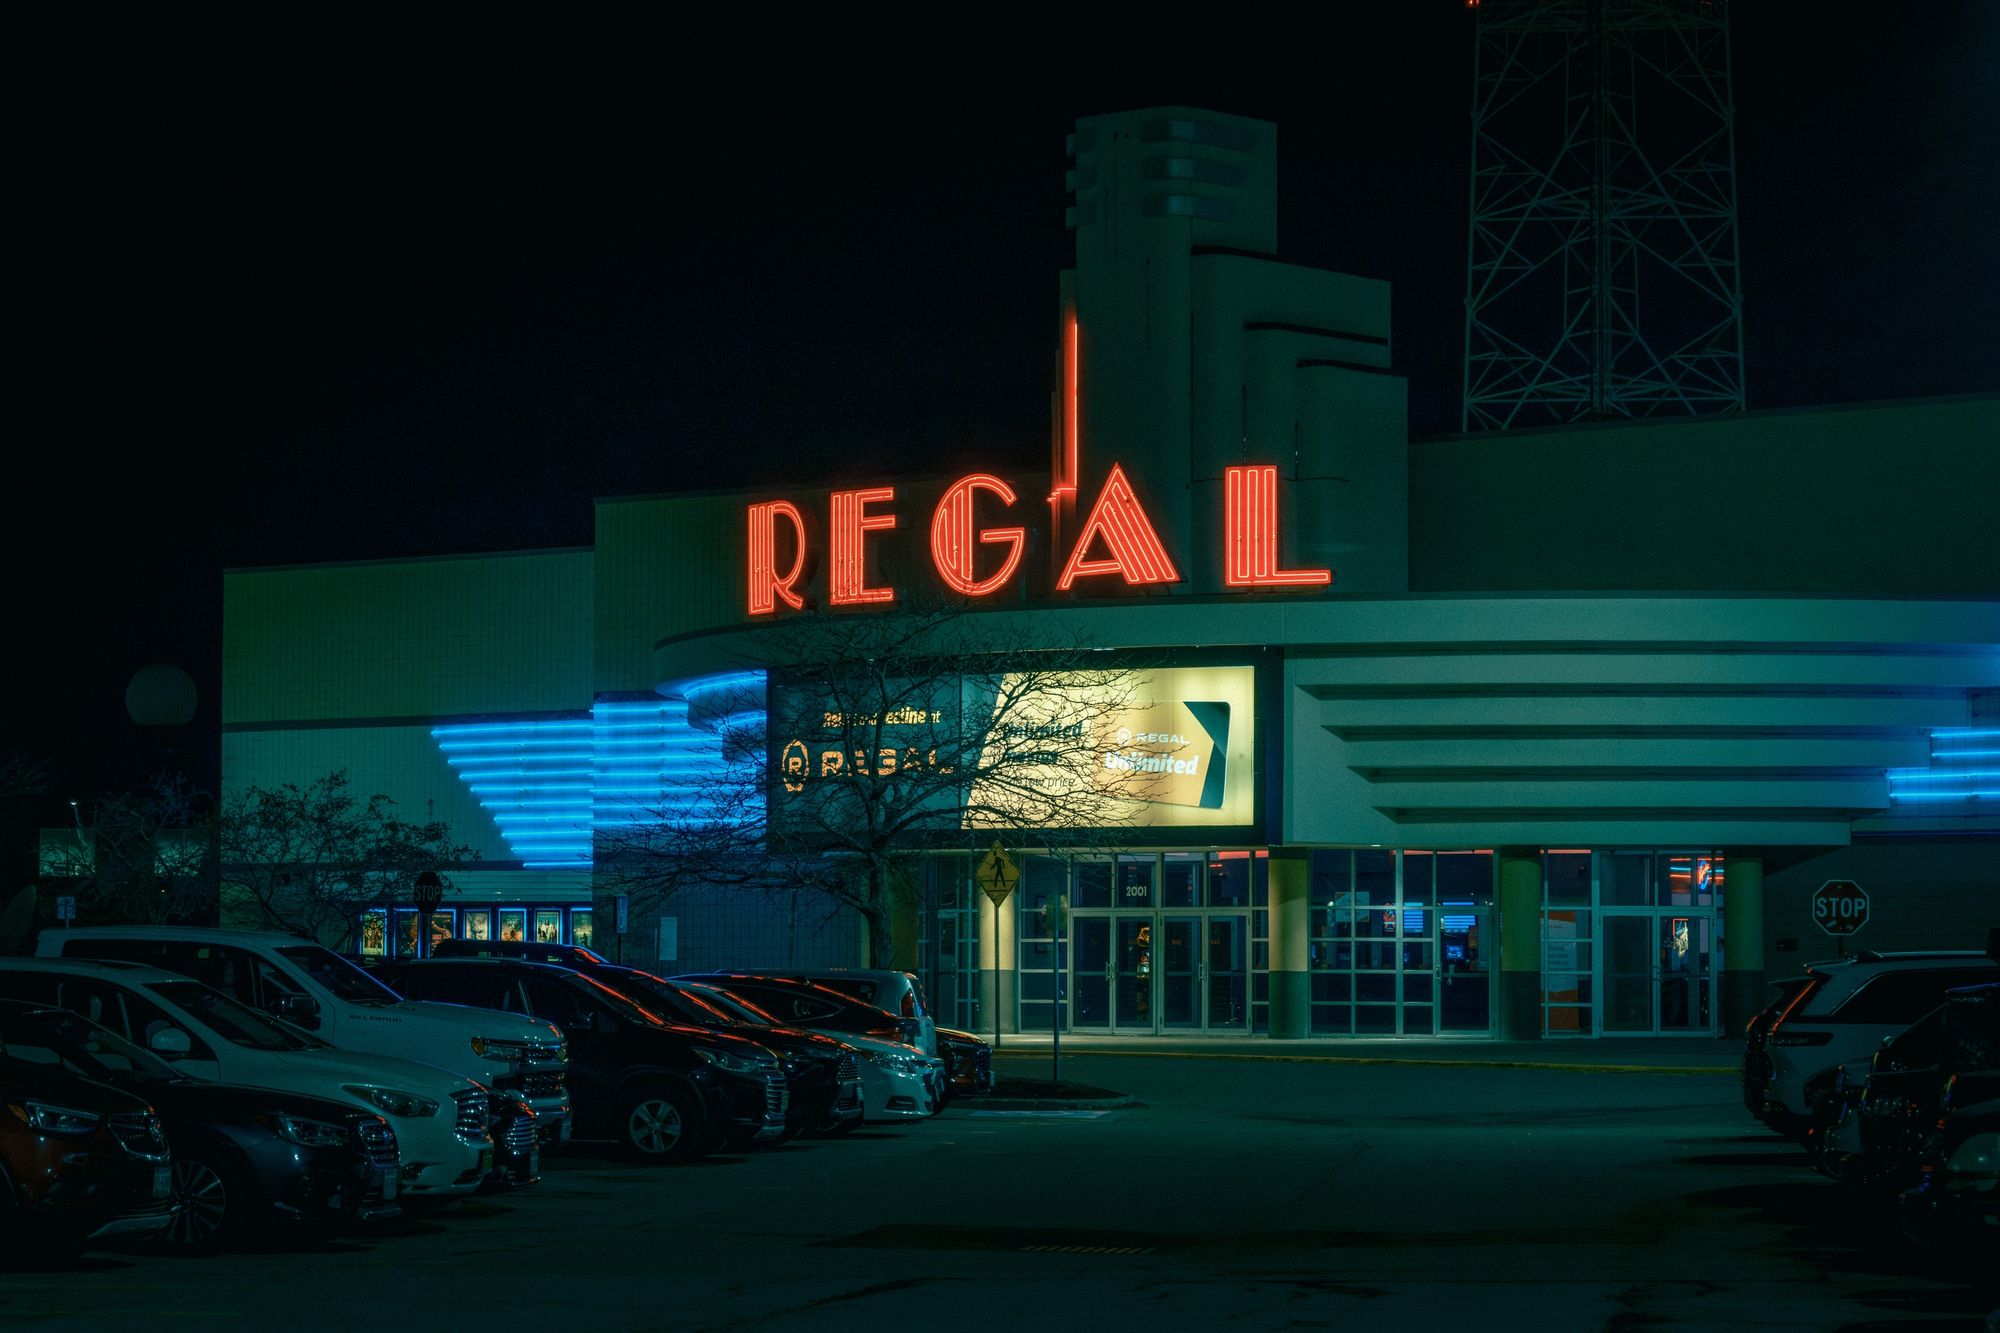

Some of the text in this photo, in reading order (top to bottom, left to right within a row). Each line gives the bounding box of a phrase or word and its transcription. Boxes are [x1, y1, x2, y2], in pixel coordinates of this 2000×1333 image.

[747, 462, 1332, 615] REGAL
[879, 706, 927, 725] ecline
[1136, 732, 1187, 744] REGAL
[1106, 751, 1199, 775] Unlimited
[415, 884, 441, 902] STOP
[1126, 885, 1147, 897] 2001
[1816, 897, 1866, 918] STOP
